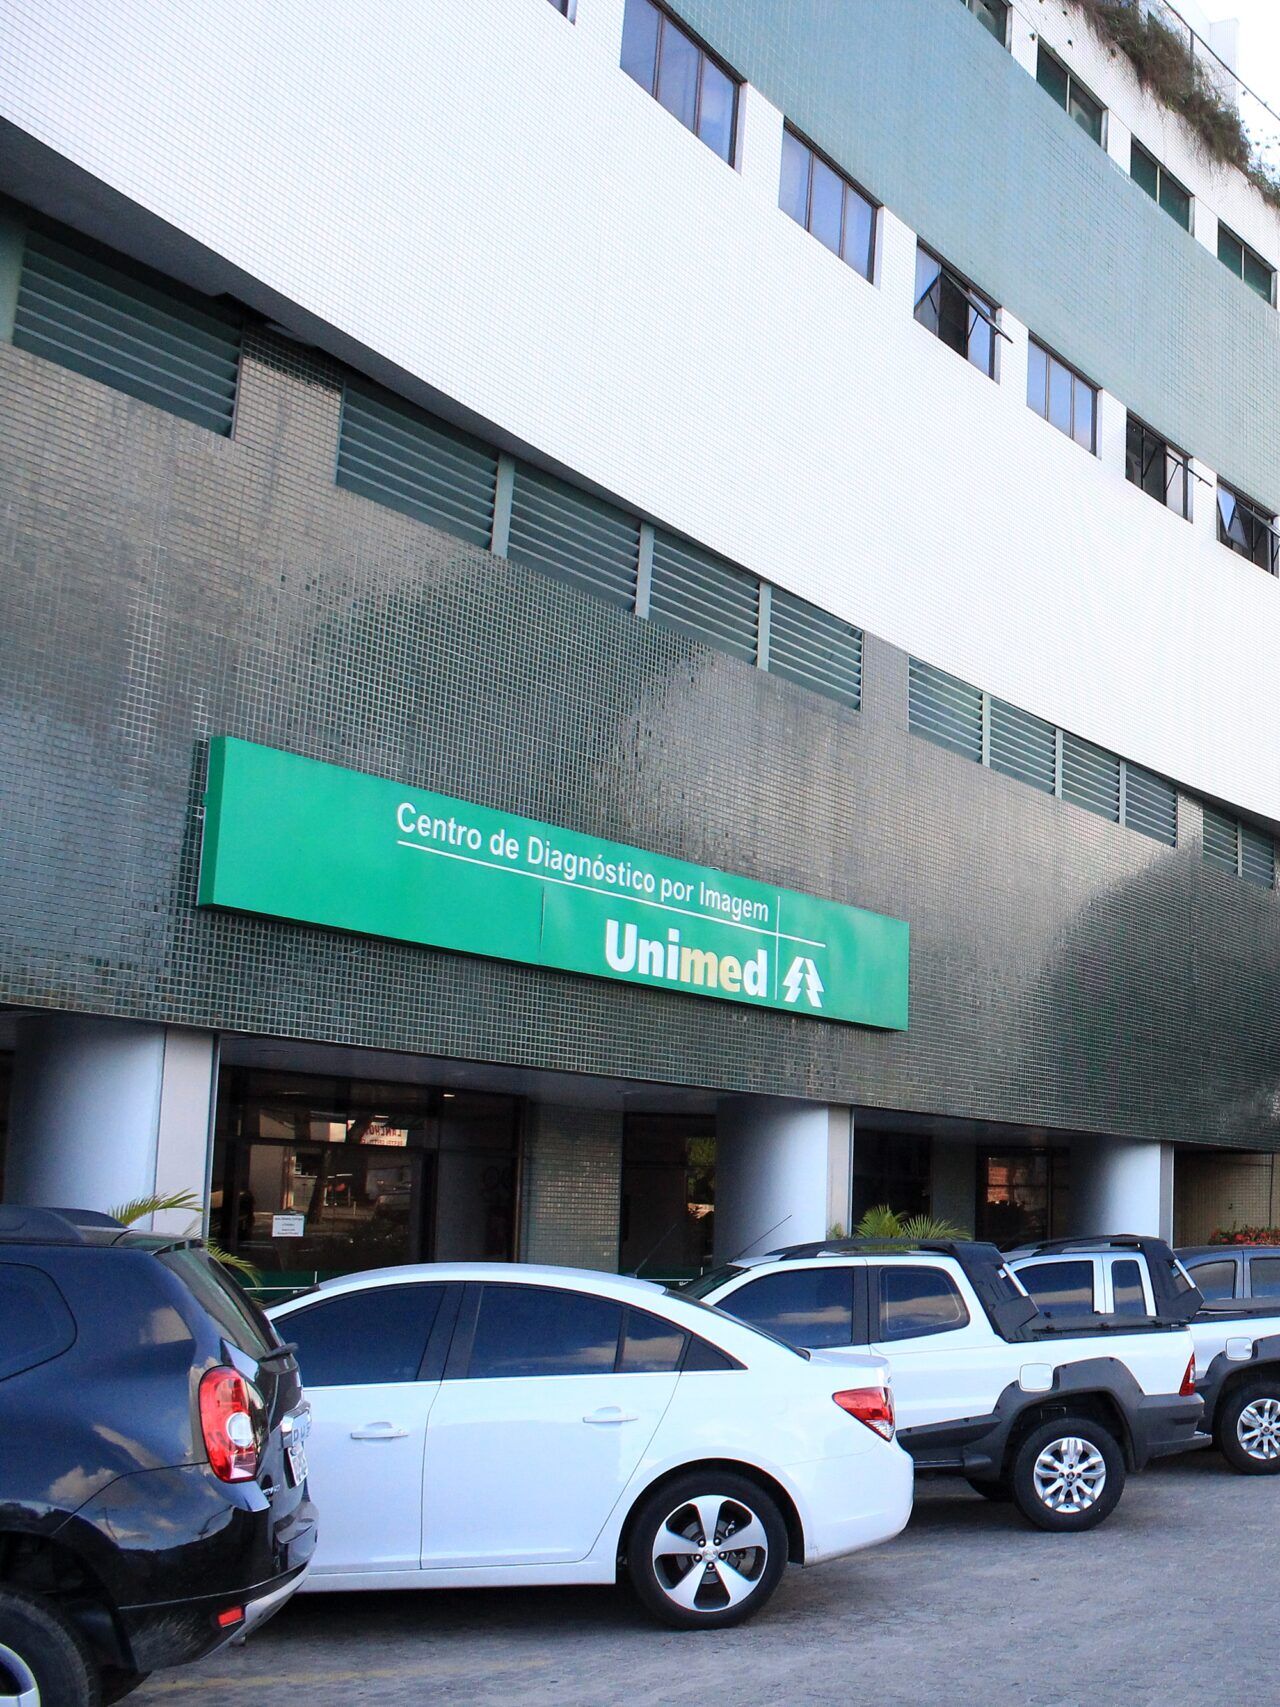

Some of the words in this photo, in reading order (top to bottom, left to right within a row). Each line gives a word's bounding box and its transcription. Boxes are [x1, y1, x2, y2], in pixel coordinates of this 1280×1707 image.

[397, 803, 481, 849] Centro
[490, 829, 520, 859] de
[528, 836, 656, 893] Diagnóstico
[660, 877, 695, 902] por
[699, 882, 769, 922] Imagem
[605, 919, 767, 997] Unimed
